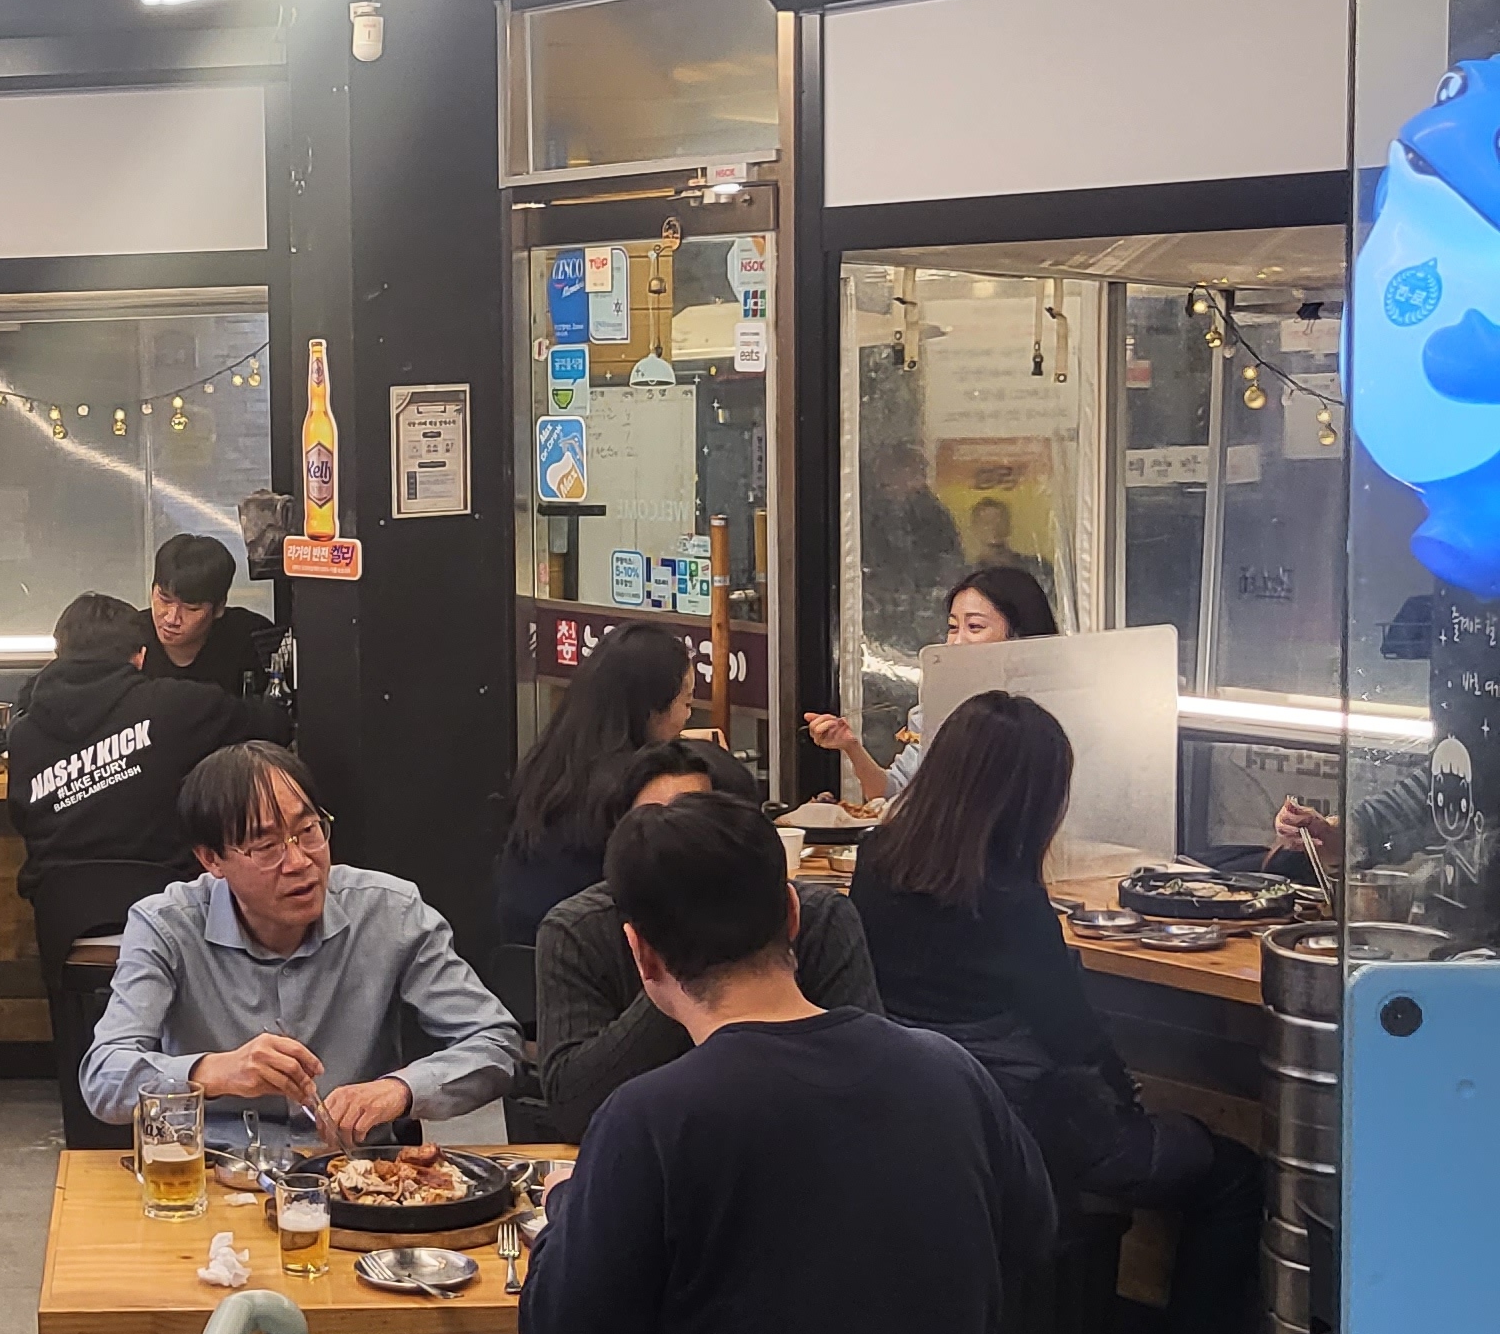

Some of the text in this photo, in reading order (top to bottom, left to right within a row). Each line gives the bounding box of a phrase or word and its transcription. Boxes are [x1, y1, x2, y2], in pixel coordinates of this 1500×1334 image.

[552, 258, 584, 280] CESCO
[740, 260, 765, 272] NSOK
[744, 298, 766, 310] JCB
[740, 349, 760, 362] eats
[306, 460, 332, 485] Kelly
[560, 468, 578, 498] Max
[287, 545, 355, 567] 라거의 반전 켈리
[557, 620, 579, 665] 천호
[53, 764, 142, 813] BASE/FLAME/CRUSH
[57, 758, 127, 800] #LIKE FURY
